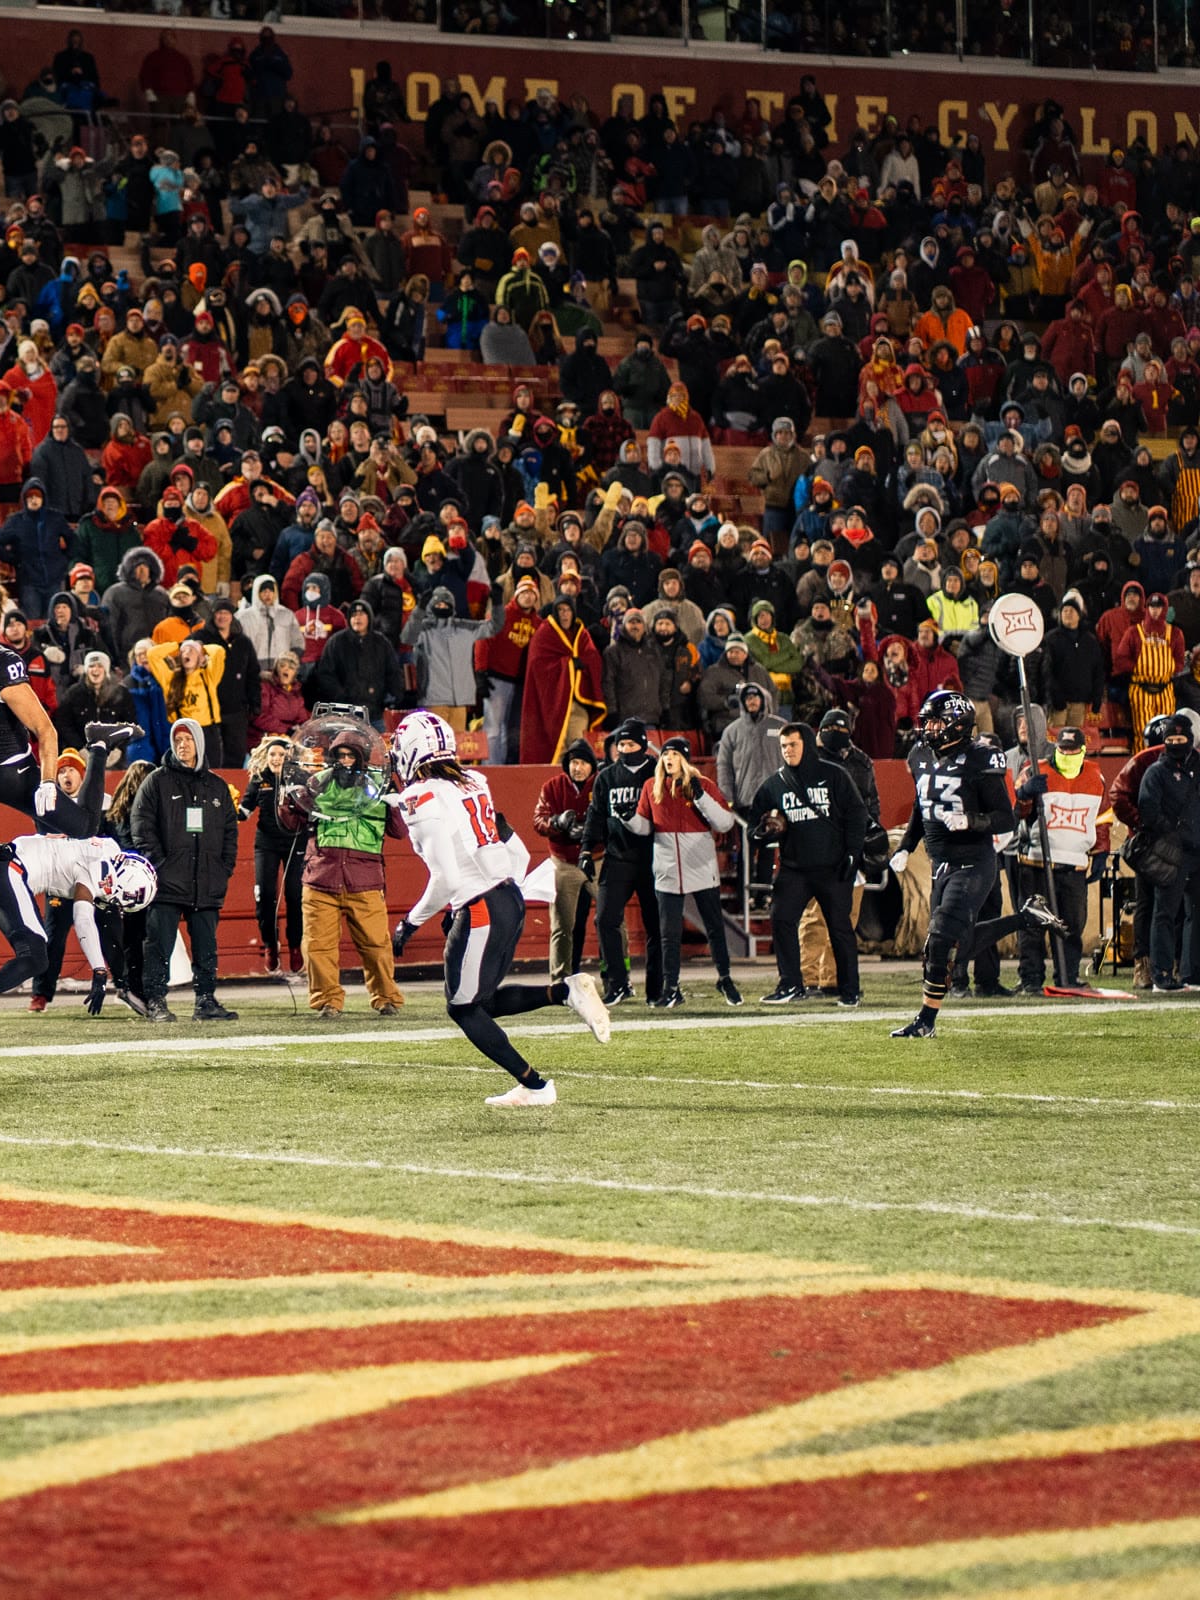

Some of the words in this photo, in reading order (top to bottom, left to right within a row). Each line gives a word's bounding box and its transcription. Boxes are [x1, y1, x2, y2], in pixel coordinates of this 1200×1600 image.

[611, 83, 696, 131] OF
[938, 100, 1200, 155] CYLON
[7, 661, 27, 680] 87
[989, 753, 1006, 769] 43
[782, 787, 831, 810] CYONE
[916, 774, 964, 822] 43
